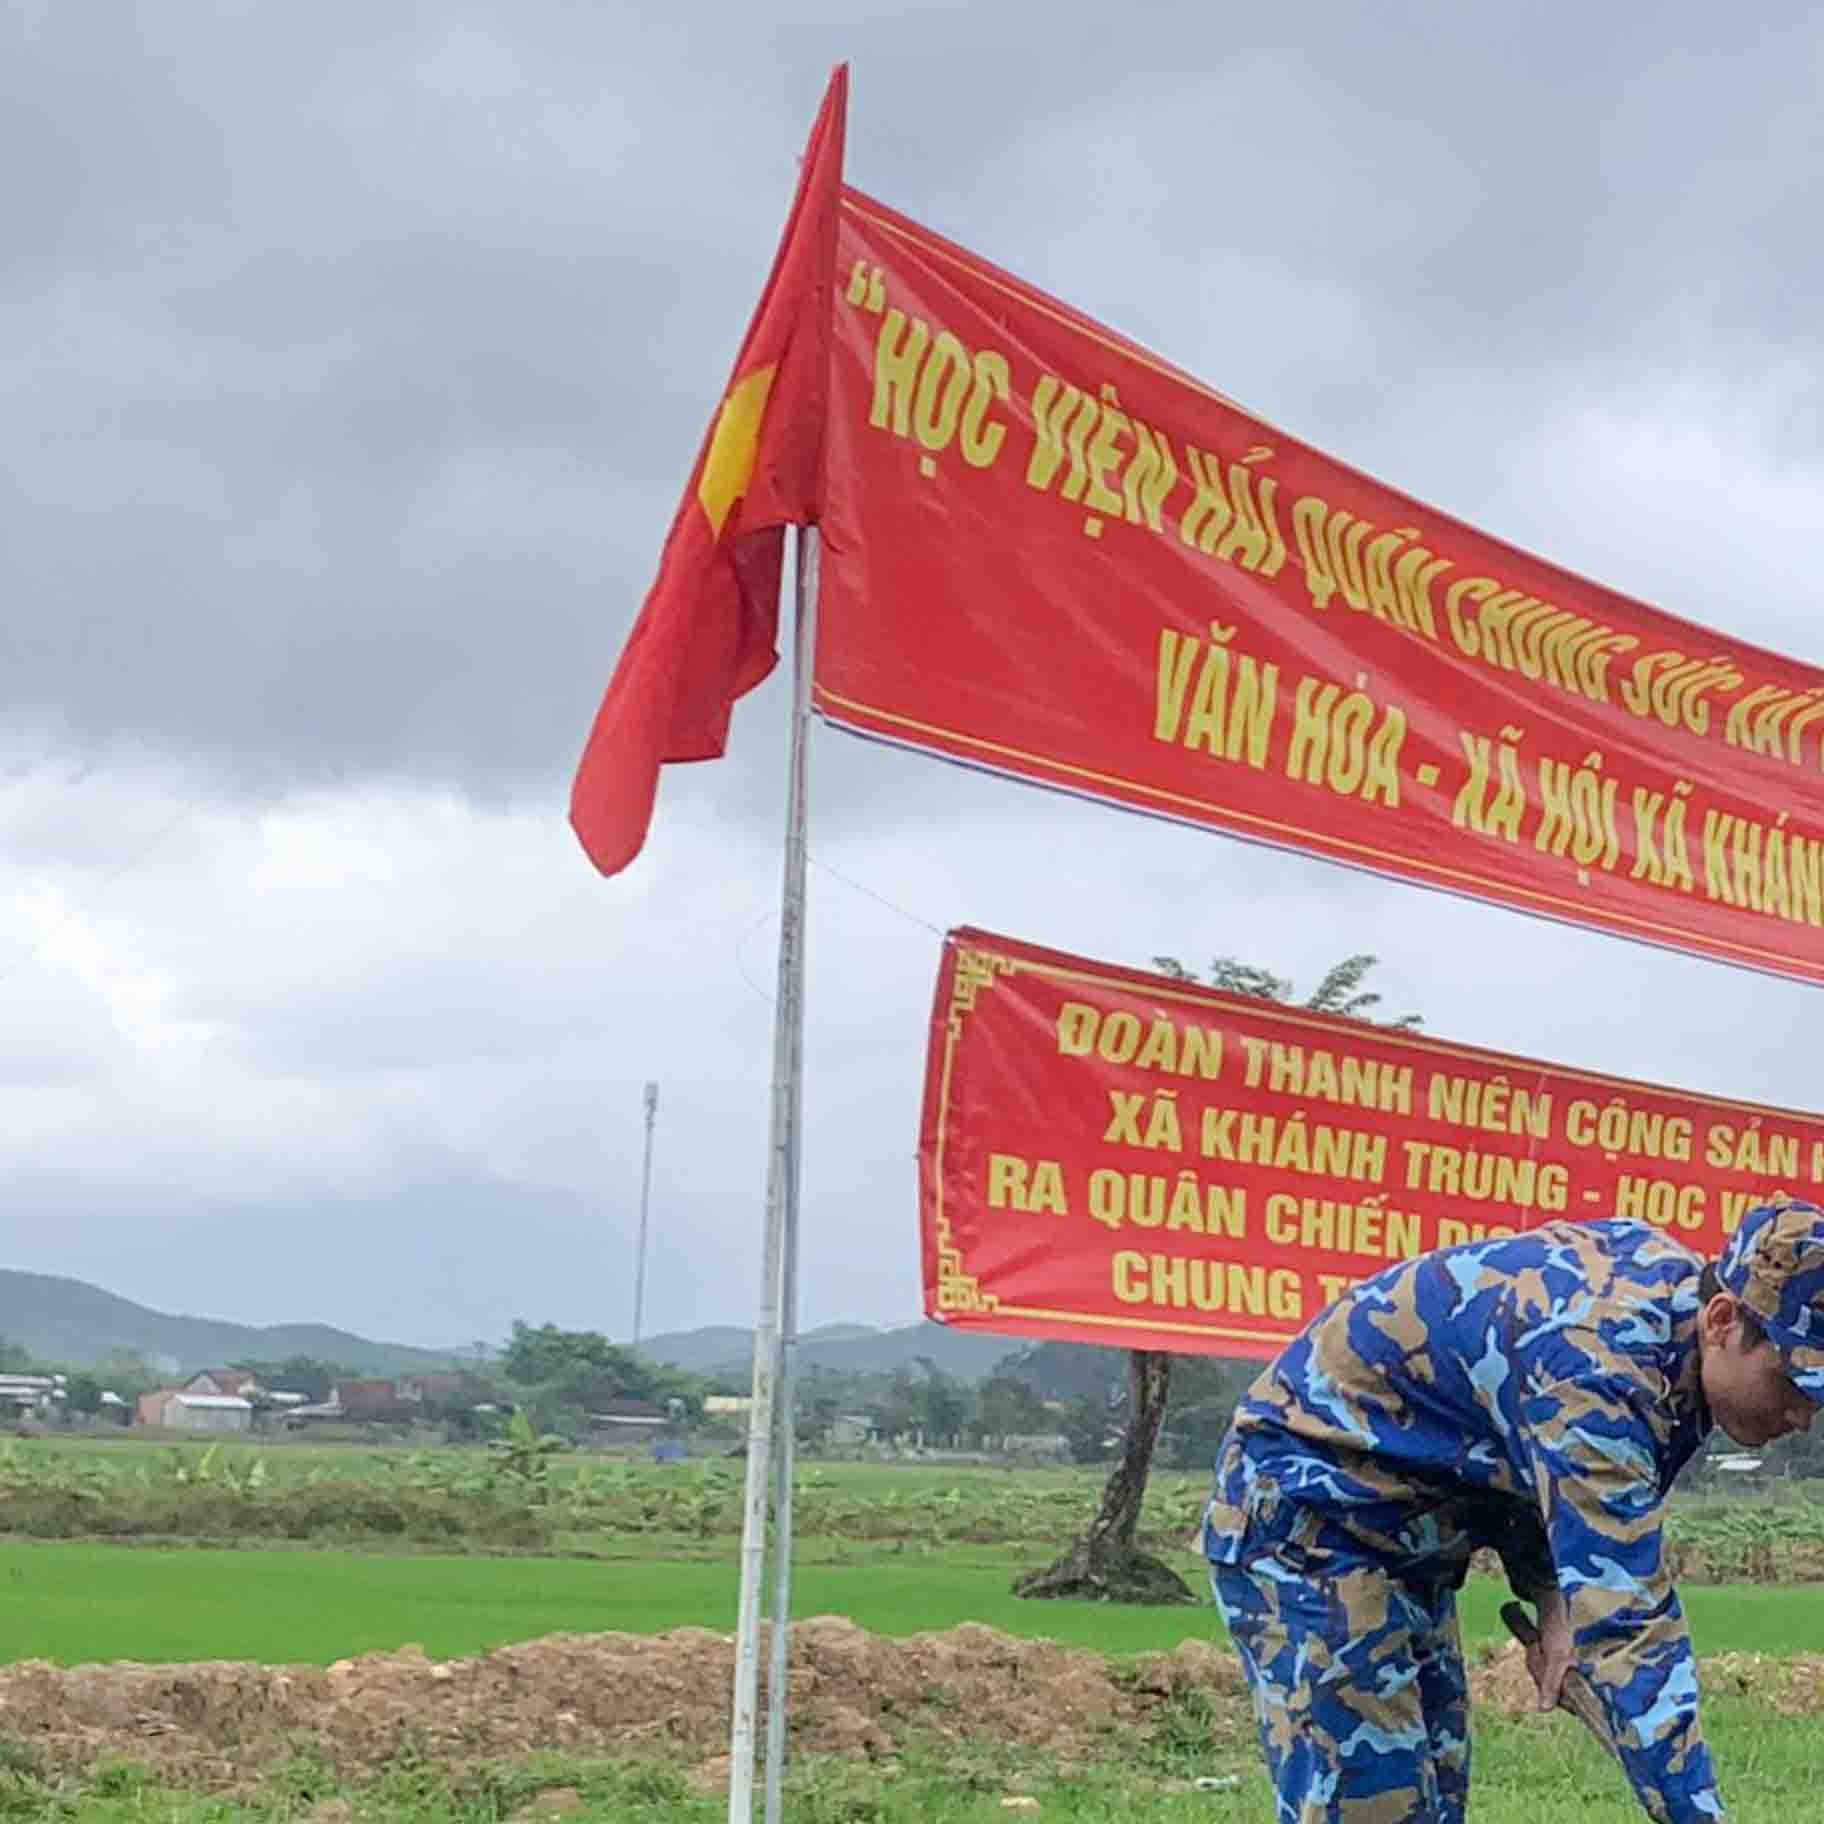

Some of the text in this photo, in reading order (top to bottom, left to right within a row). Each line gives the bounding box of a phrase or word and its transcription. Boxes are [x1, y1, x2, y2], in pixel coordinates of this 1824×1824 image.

[1026, 375, 1177, 539] VIỆN
[1293, 497, 1455, 640] QUÂN
[1446, 577, 1639, 703] CHUNG
[1620, 651, 1744, 736] SỨC
[1153, 619, 1280, 770] VĂN
[1285, 671, 1408, 808] HÓA
[1452, 724, 1526, 843] XÃ
[1535, 751, 1619, 887] HỘI
[1629, 780, 1696, 894] XÃ
[1056, 1001, 1223, 1080] ĐOÀN
[1241, 1036, 1411, 1114] THANH
[1427, 1072, 1553, 1140] NIÊN
[1566, 1096, 1693, 1162] CỘNG
[1103, 1088, 1183, 1152] XÃ
[1200, 1110, 1387, 1184] KHÁNH
[1402, 1141, 1570, 1211] TRUNG
[988, 1154, 1068, 1216] RA
[1088, 1169, 1246, 1237] QUÂN
[1265, 1193, 1421, 1259] CHIẾN
[1112, 1250, 1303, 1319] CHUNG
